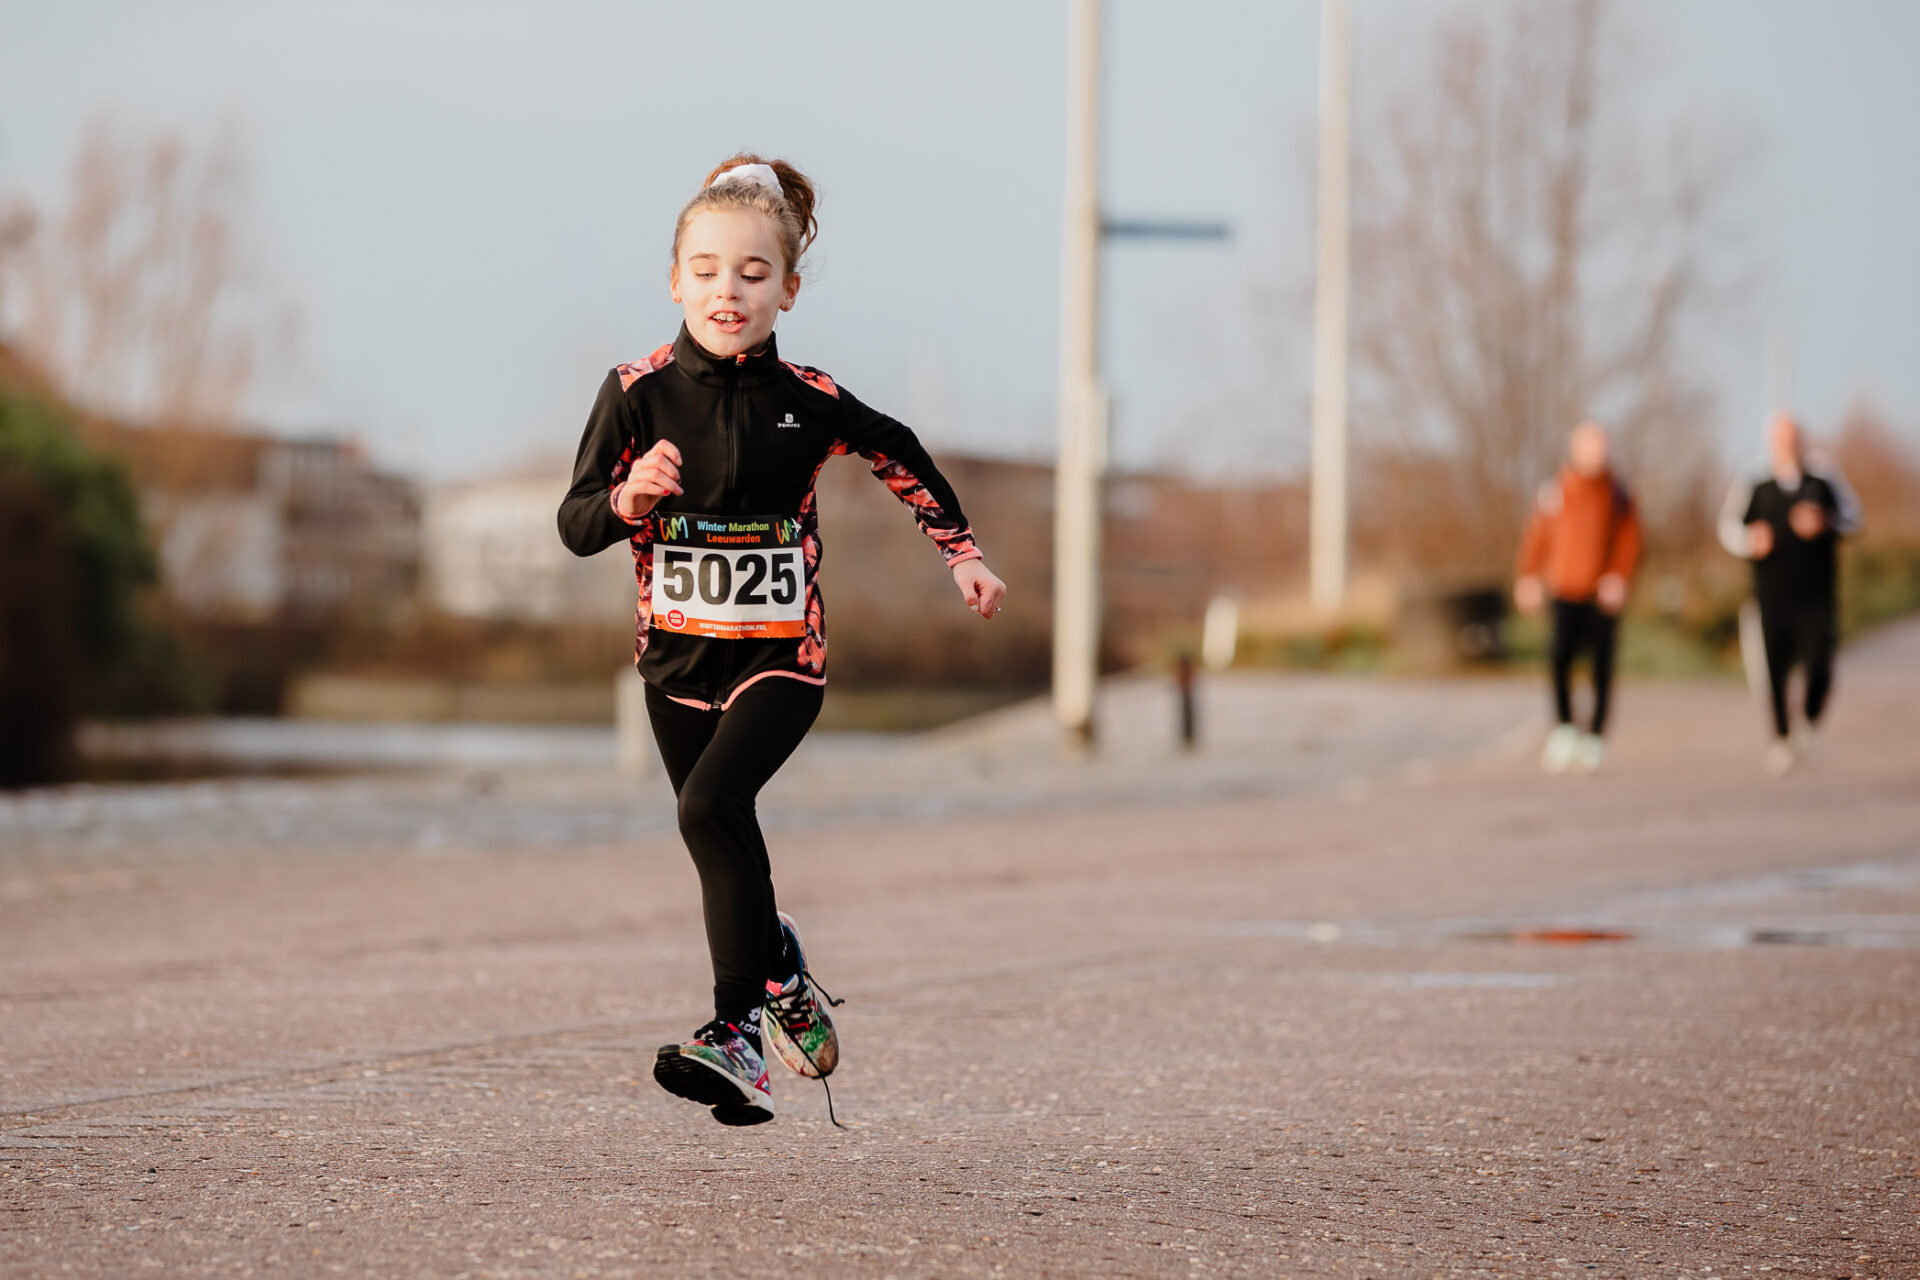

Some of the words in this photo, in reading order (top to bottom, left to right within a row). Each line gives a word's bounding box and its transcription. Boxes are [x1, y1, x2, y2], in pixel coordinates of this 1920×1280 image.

[697, 520, 727, 532] Winter
[728, 522, 769, 532] Marathon
[706, 533, 761, 544] Leeuwarden
[663, 550, 797, 605] 5025
[699, 622, 768, 631] WINTERMARATHON.FRL
[738, 1020, 761, 1036] LOTT
